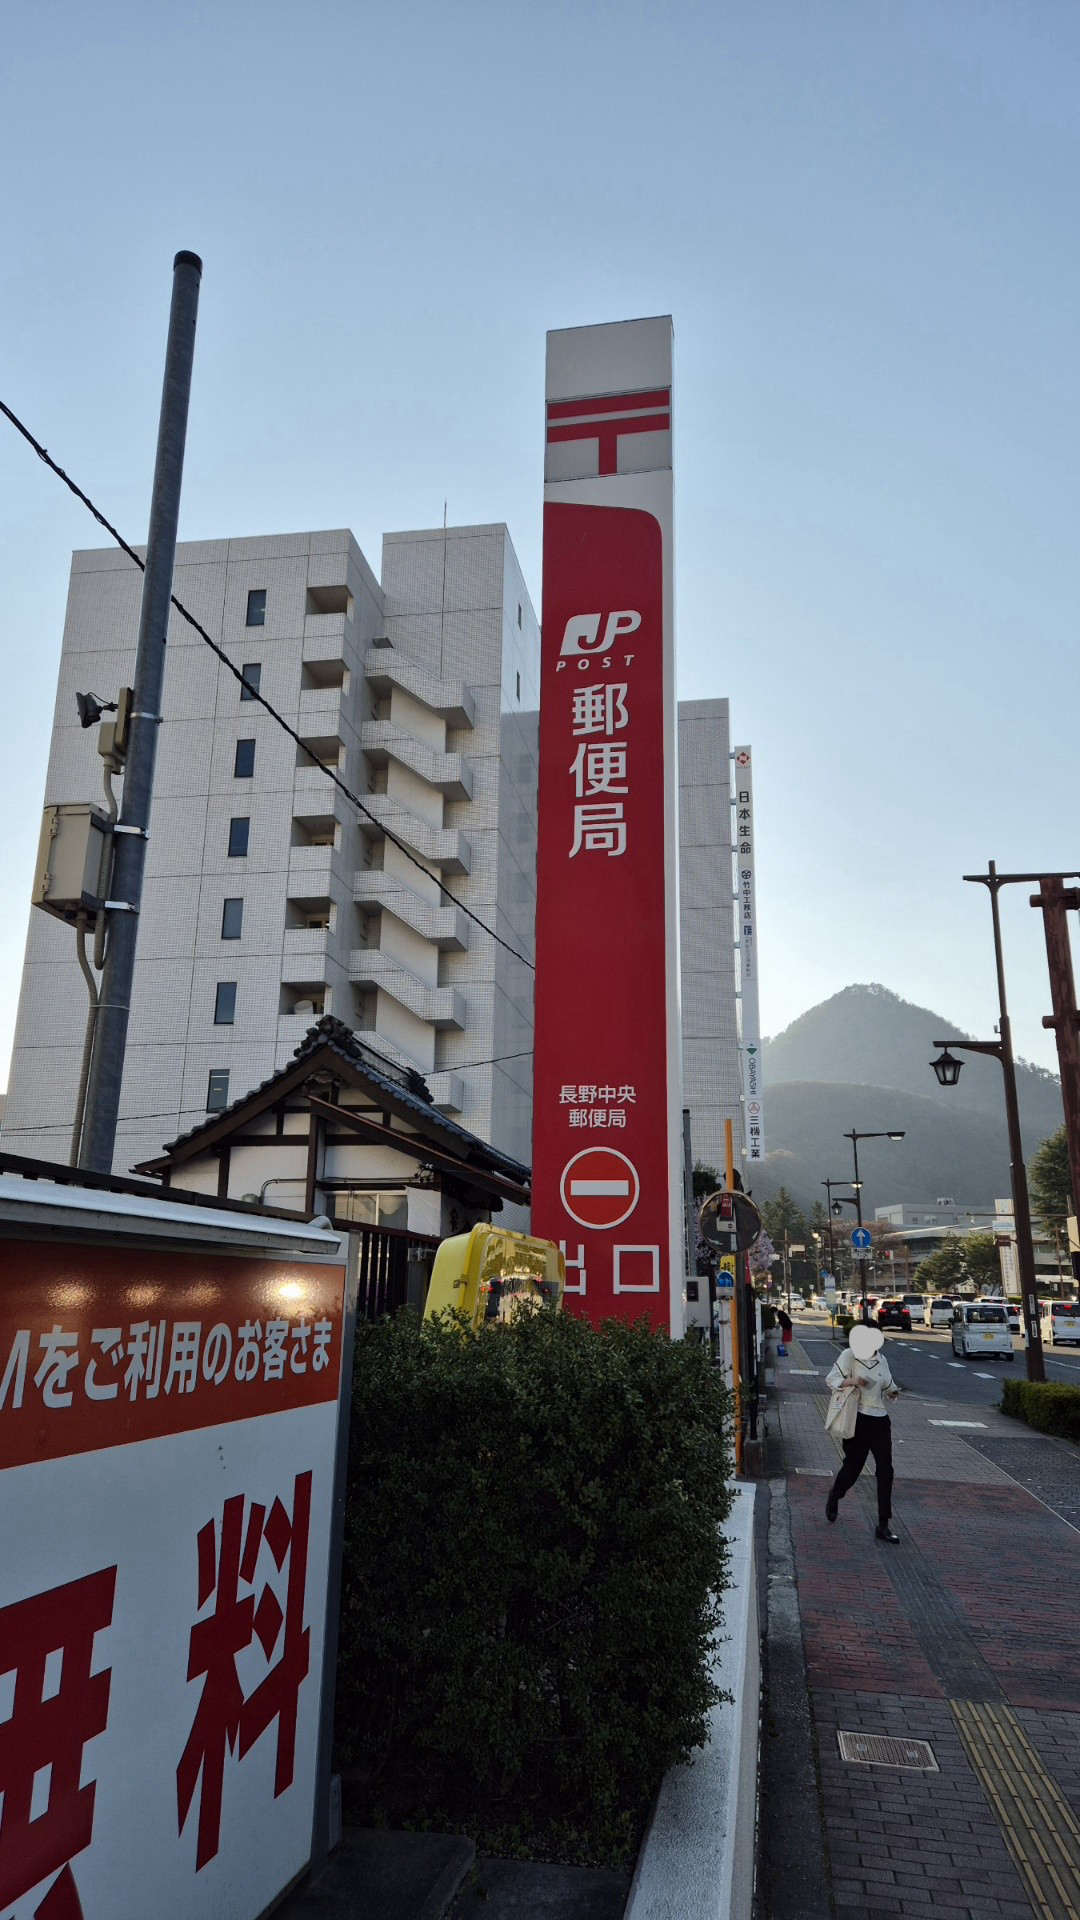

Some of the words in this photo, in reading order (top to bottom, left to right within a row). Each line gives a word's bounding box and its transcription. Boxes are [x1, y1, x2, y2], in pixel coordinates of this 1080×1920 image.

[556, 654, 635, 672] POST
[569, 683, 630, 858] 郵便局
[739, 791, 752, 853] 日本生命
[743, 881, 752, 920] 竹中工務店
[559, 1085, 637, 1105] 長野中央
[569, 1109, 627, 1128] 郵便局
[750, 1115, 760, 1159] 三機工業
